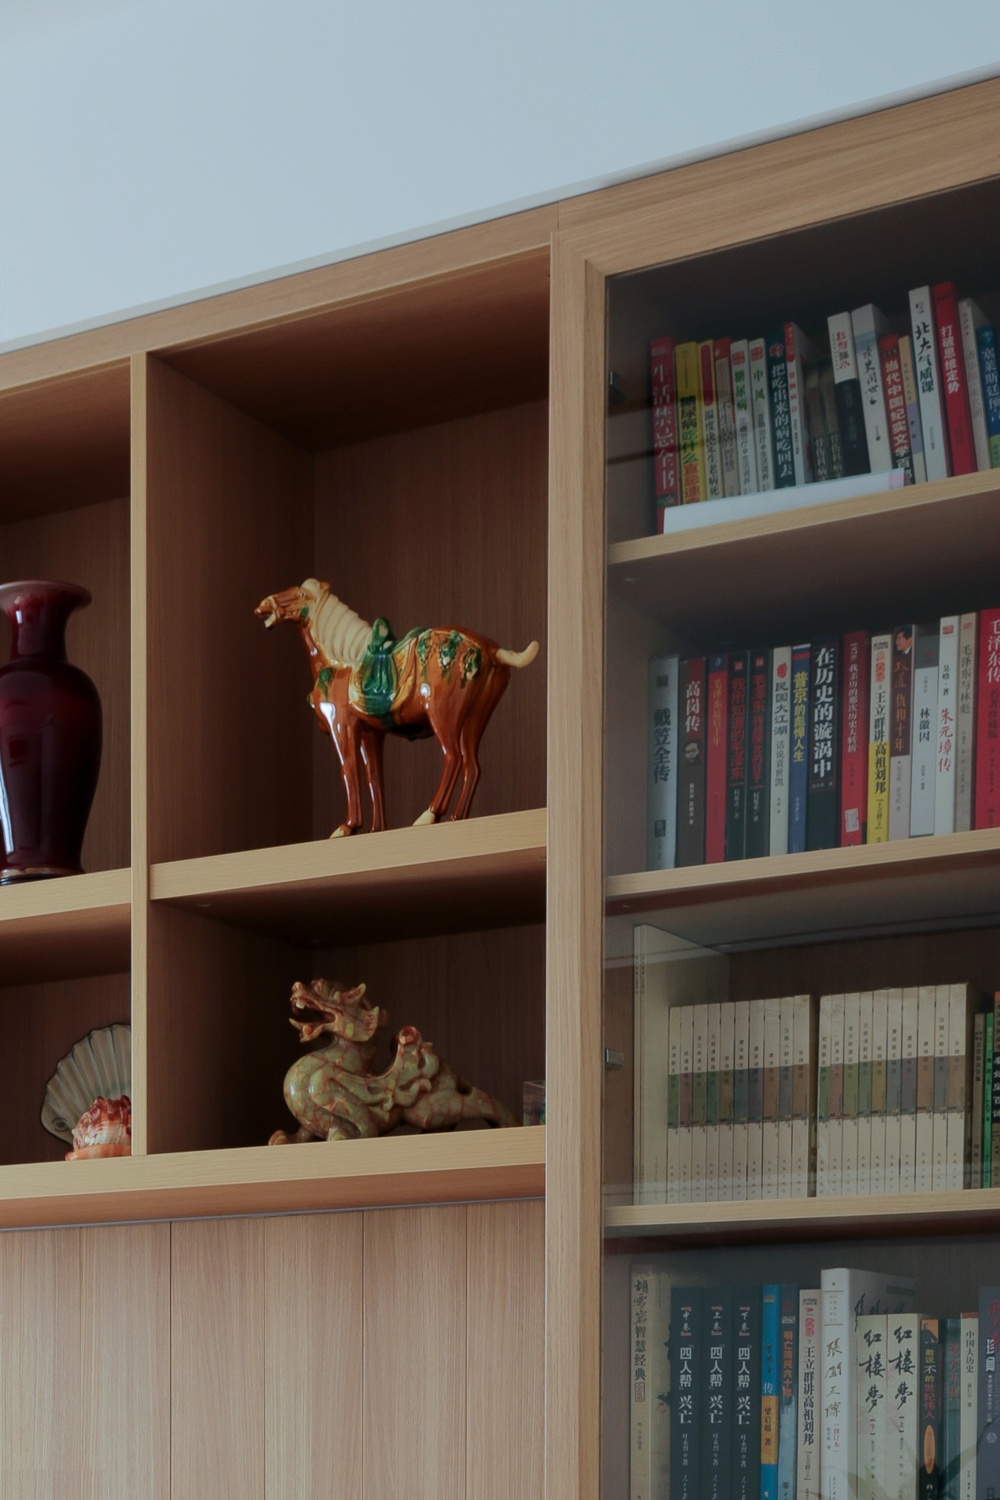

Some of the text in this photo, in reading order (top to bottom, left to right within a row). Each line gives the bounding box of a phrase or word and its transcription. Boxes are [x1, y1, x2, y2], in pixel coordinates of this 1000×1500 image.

[734, 370, 748, 411] 糖尿病
[752, 370, 766, 401] 中风
[914, 321, 935, 393] 北大气质课
[940, 324, 960, 395] 打破思维定势
[703, 409, 721, 497] 温度决定生老病死
[719, 401, 736, 473] 不生病的智慧
[771, 362, 793, 478] 把吃出来的病吃回去
[685, 680, 701, 734] 高岗传
[712, 677, 723, 746] 毛泽东最后十年
[813, 647, 835, 779] 在历史的漩涡中
[847, 663, 859, 753] 我亲历的那次历史大转折
[960, 644, 972, 715] 毛泽东与林彪
[653, 707, 671, 784] 戴笠全传
[730, 676, 746, 780] 我所知道的毛泽东
[773, 681, 788, 787] 民国大江湖 话说袁世凯
[793, 671, 808, 763] 普京的彪悍人生
[873, 691, 887, 794] 王立群讲高祖刘邦
[894, 692, 907, 752] 仇和十年
[919, 707, 931, 743] 林徽因
[938, 707, 954, 773] 朱元璋传
[633, 1279, 649, 1381] 胡雪岩智慧经典
[783, 1330, 793, 1398] 明亡清兴六十年
[965, 1330, 975, 1374] 中国大历史
[802, 1345, 815, 1446] 王立群讲高祖刘邦
[923, 1348, 937, 1420] 敢说不的世纪伟人
